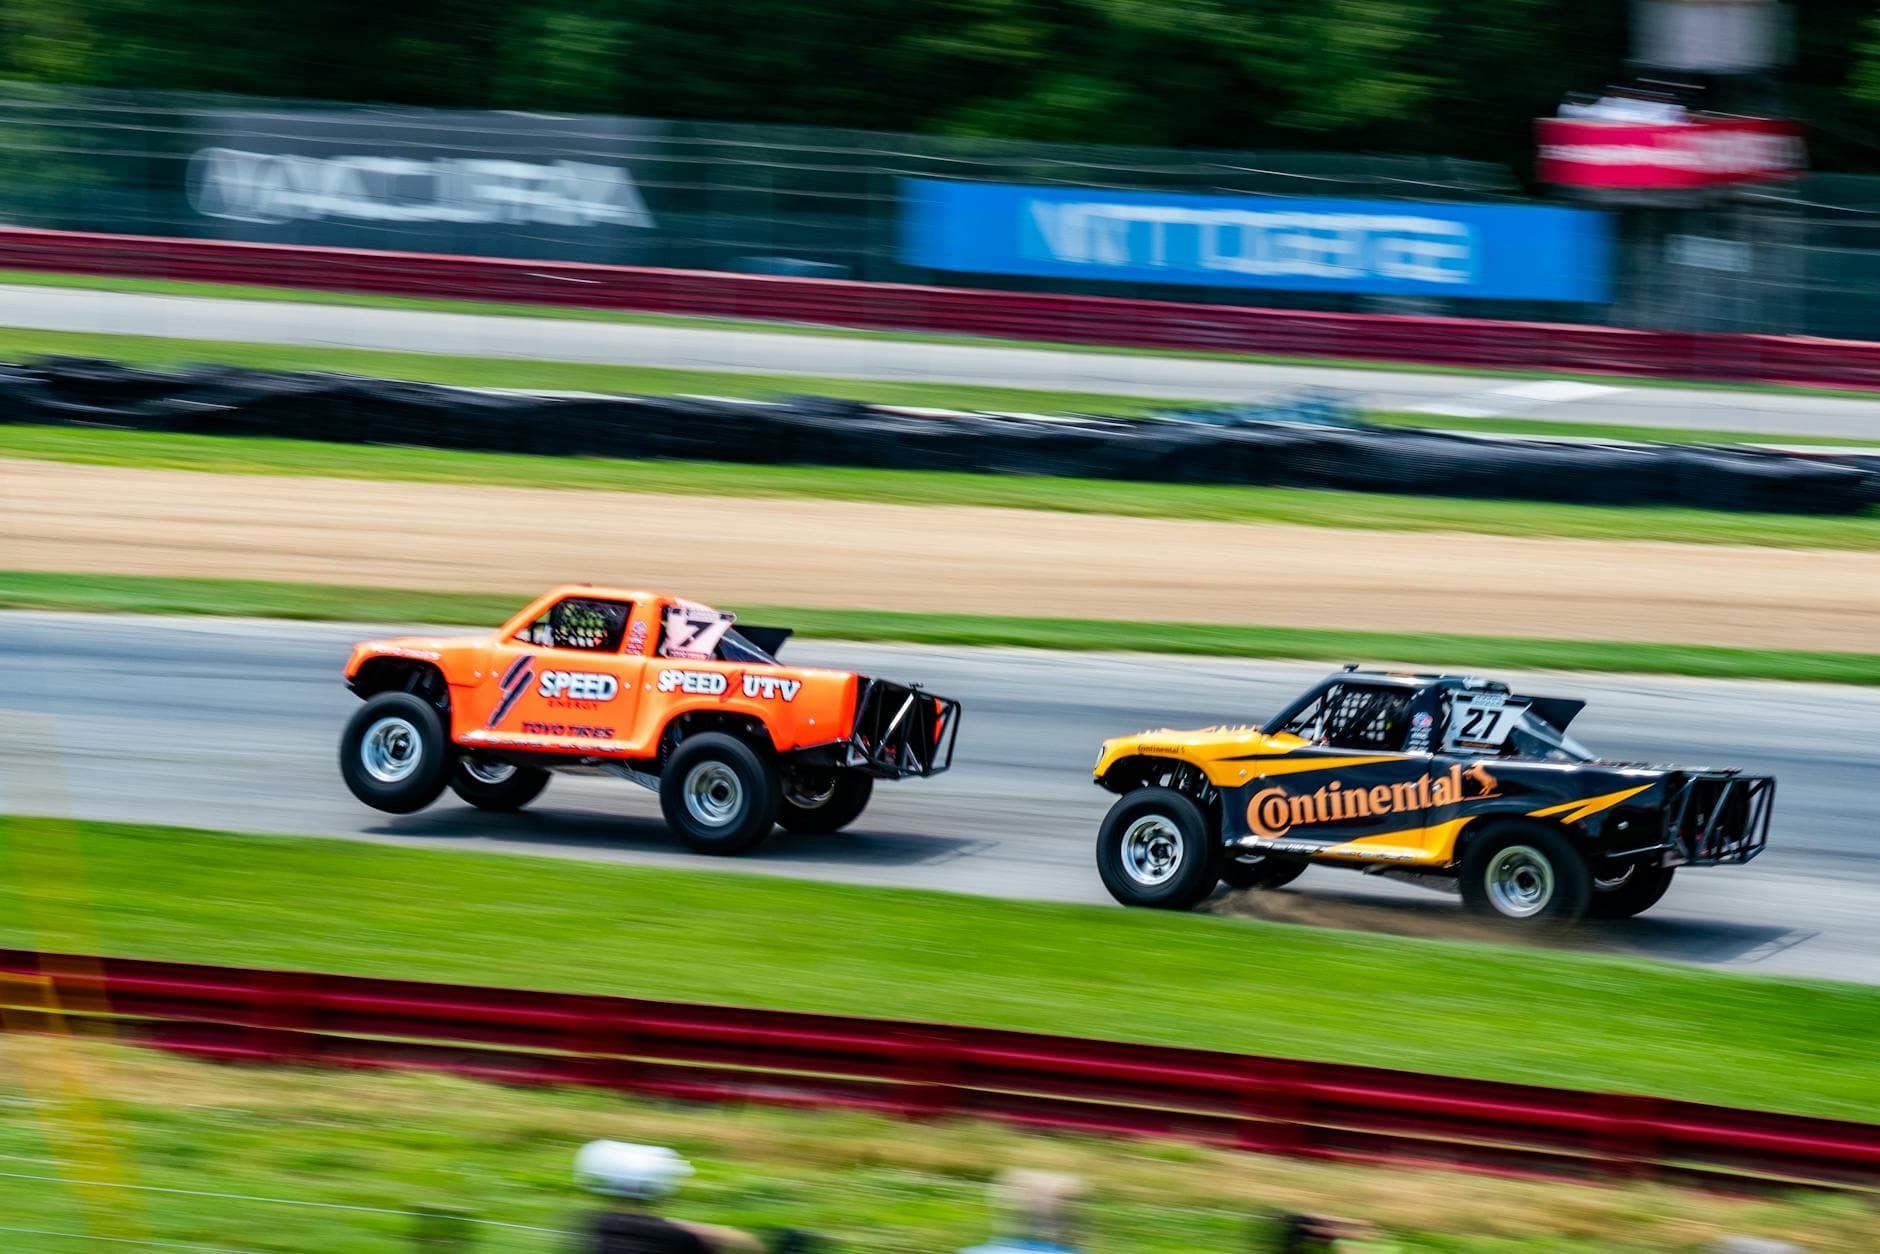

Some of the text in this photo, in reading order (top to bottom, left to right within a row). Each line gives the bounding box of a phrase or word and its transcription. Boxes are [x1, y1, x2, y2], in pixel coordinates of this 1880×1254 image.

[679, 619, 714, 647] 7
[538, 669, 619, 701] SPEED
[656, 669, 801, 702] SPEED UTV
[522, 722, 615, 738] TOYO TIRES
[1460, 708, 1503, 739] 27
[1137, 744, 1180, 754] Continental
[1246, 763, 1465, 839] Continental
